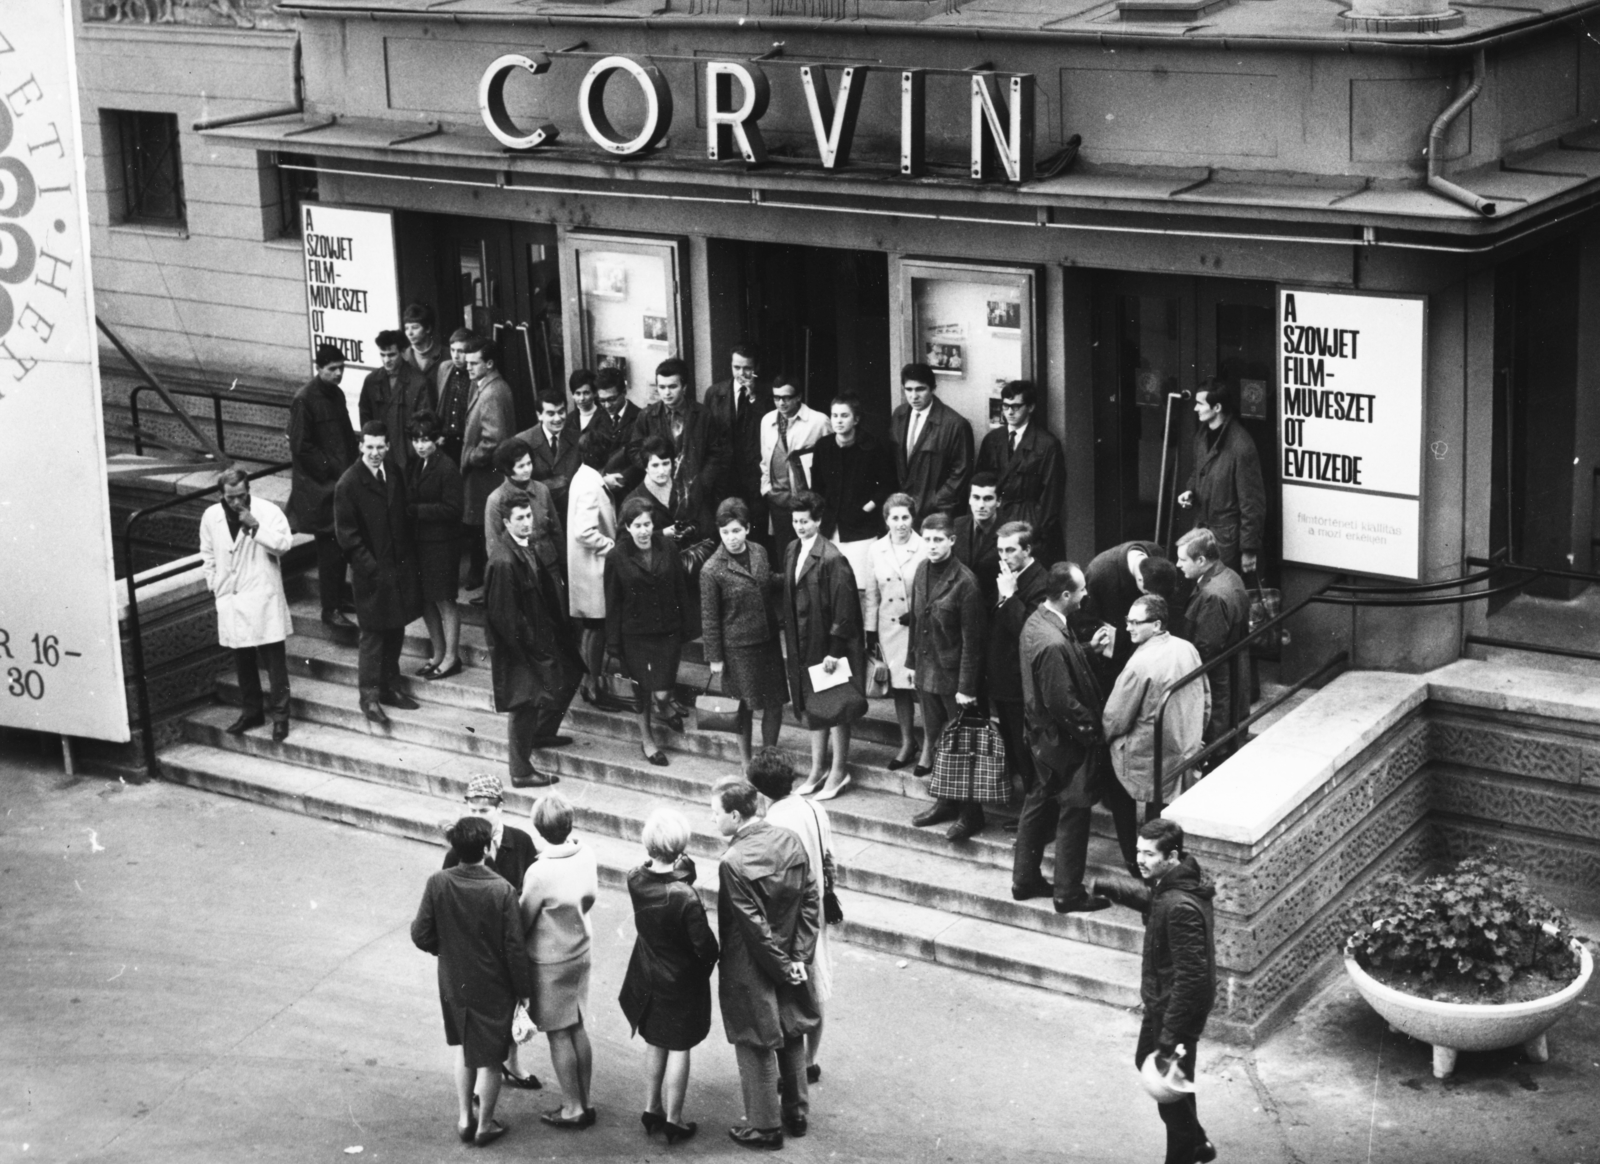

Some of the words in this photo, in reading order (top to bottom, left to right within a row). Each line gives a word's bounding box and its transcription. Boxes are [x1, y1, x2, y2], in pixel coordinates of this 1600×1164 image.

[479, 53, 1033, 182] CORVIN
[306, 208, 314, 231] A
[306, 233, 353, 261] SZOVJET
[308, 259, 342, 284] FILM-
[1284, 293, 1297, 322] A
[1283, 324, 1360, 359] SZOVJET
[1284, 355, 1335, 387] FILM-
[1318, 528, 1342, 539] mozi
[7, 667, 45, 700] 30
